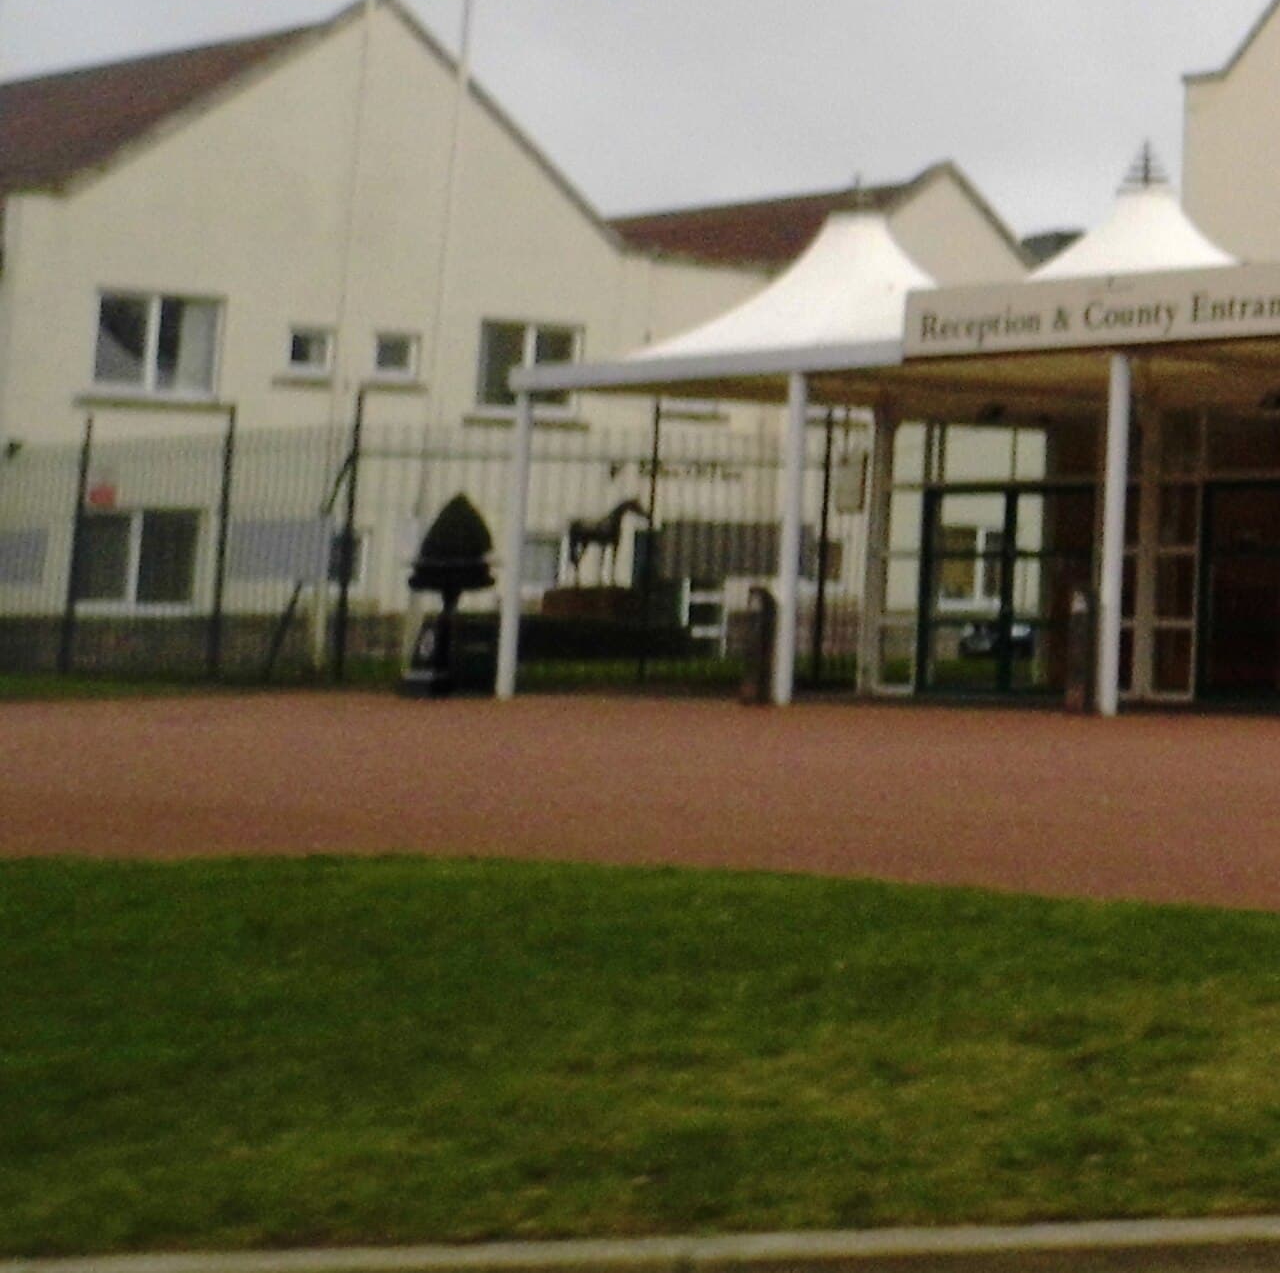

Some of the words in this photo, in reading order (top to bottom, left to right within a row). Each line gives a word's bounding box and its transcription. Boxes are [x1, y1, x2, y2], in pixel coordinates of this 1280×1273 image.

[919, 306, 1042, 348] Reception
[1052, 304, 1071, 333] &
[1083, 299, 1176, 338] County
